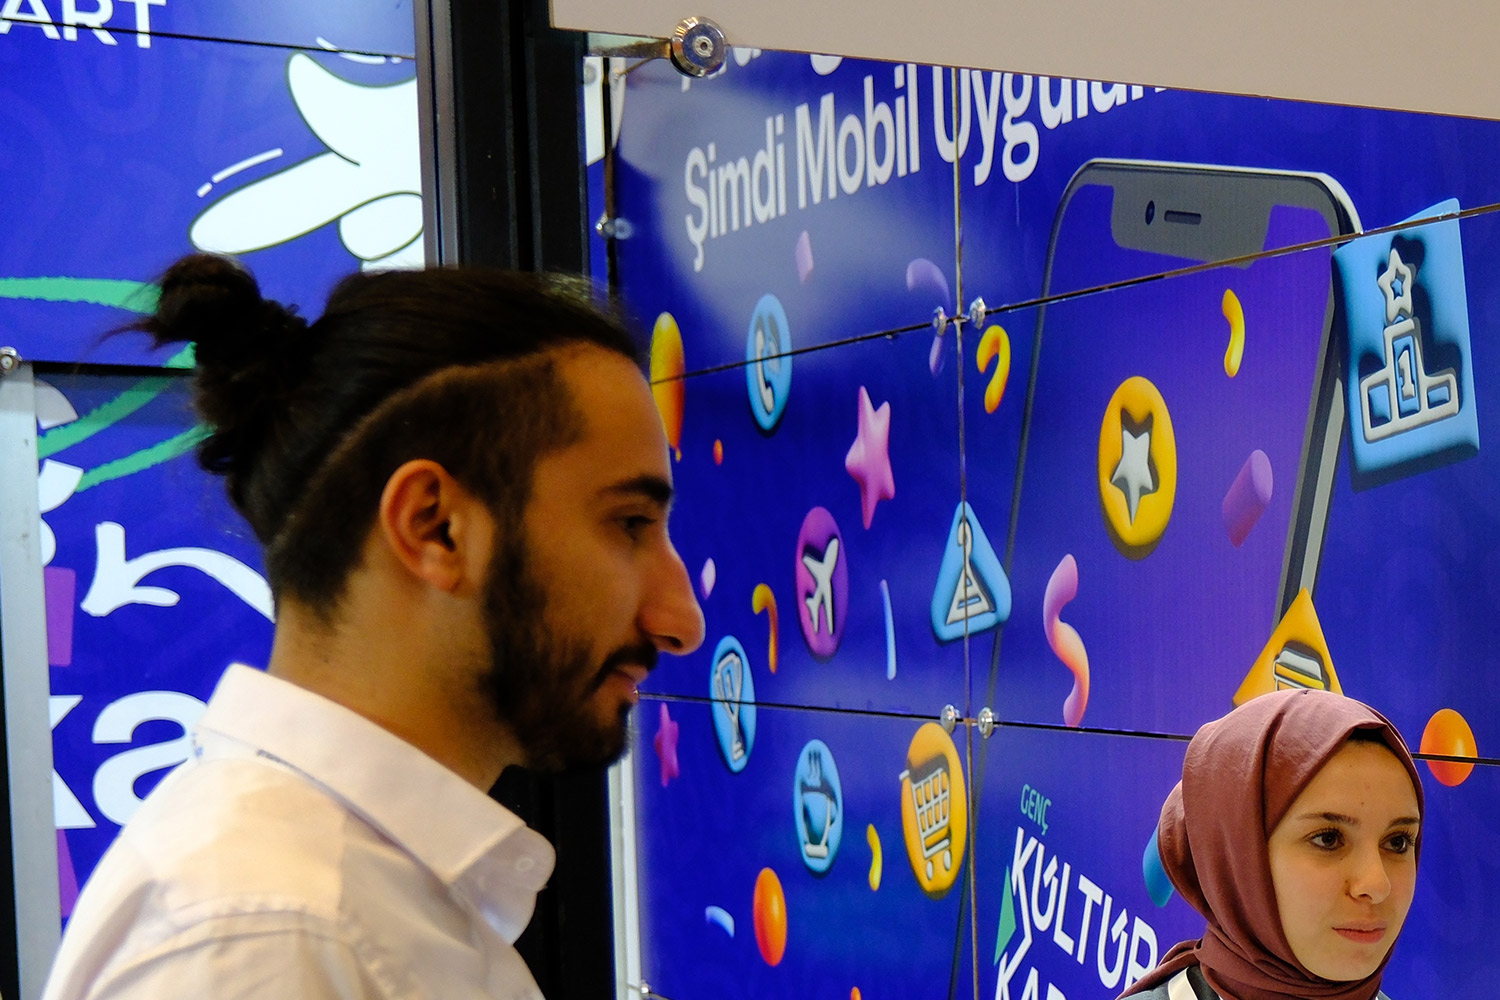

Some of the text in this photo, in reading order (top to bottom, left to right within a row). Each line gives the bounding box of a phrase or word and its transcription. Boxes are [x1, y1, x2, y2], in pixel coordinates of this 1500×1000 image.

[684, 63, 1168, 273] Şimdi Mobil Uygu
[1020, 783, 1052, 836] GENÇ
